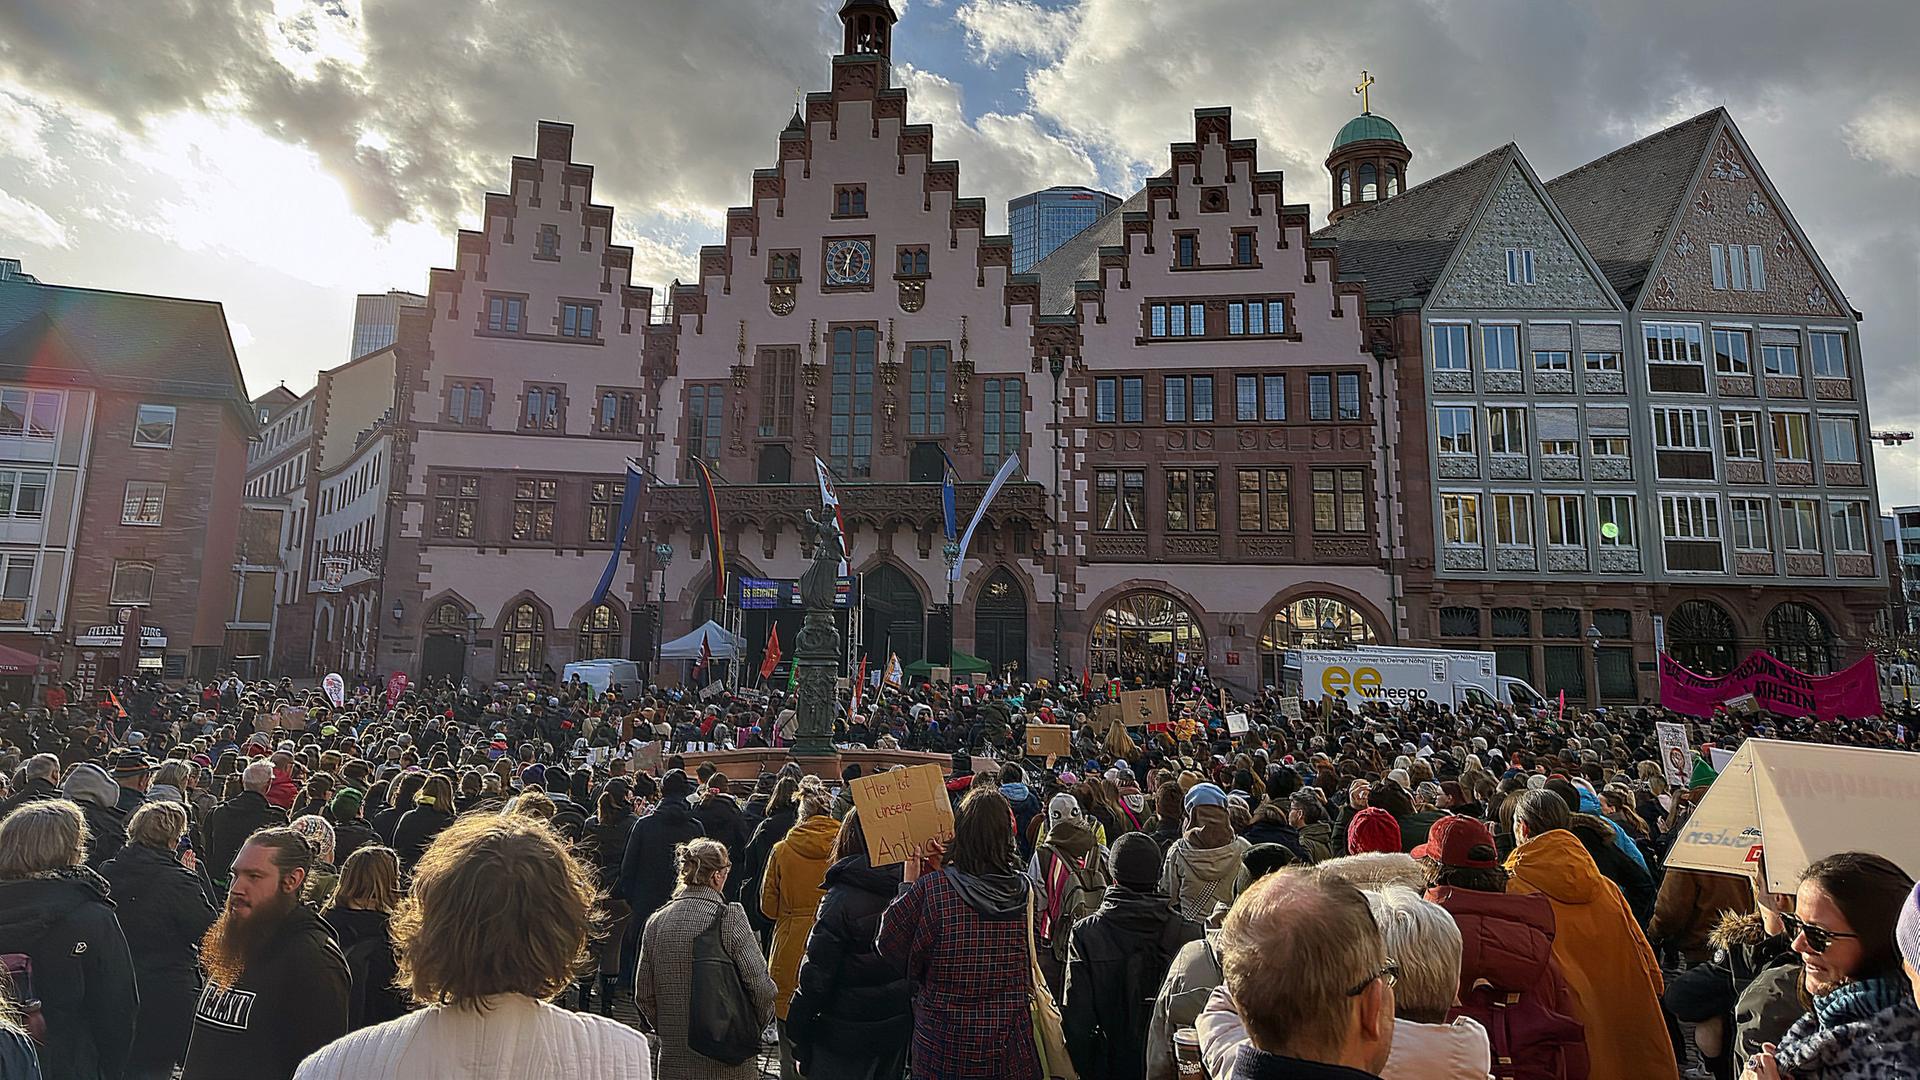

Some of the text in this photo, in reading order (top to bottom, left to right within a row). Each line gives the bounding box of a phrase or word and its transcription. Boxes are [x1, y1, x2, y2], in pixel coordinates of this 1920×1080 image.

[742, 588, 751, 598] ES
[87, 625, 118, 636] ALTEN
[1362, 684, 1428, 699] wheego
[861, 770, 911, 801] Hier ist
[874, 801, 912, 819] unsere
